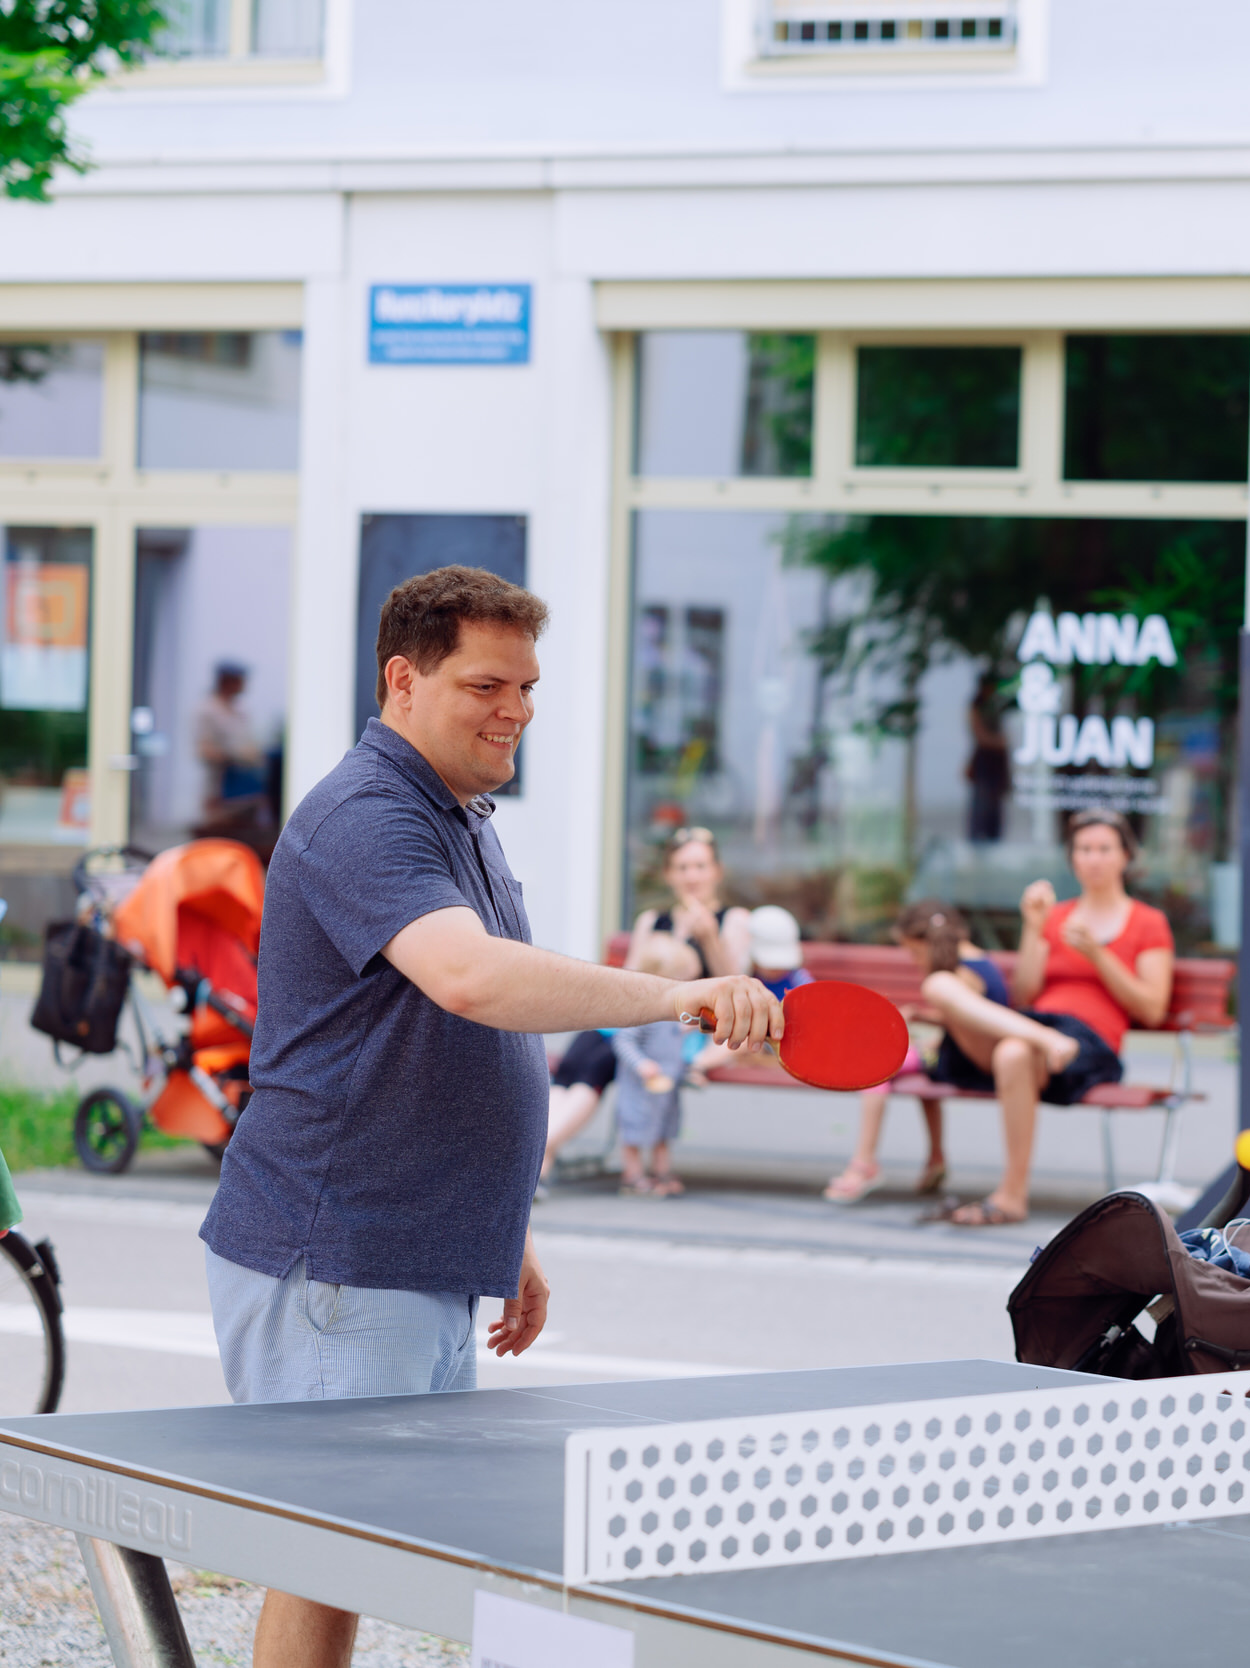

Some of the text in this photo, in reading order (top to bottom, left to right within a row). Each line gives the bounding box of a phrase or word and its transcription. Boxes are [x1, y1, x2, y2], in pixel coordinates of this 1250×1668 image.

[1018, 611, 1177, 667] ANNA
[1017, 662, 1061, 713] &
[1013, 713, 1155, 769] JUAN
[0, 1458, 192, 1550] cornilleau
